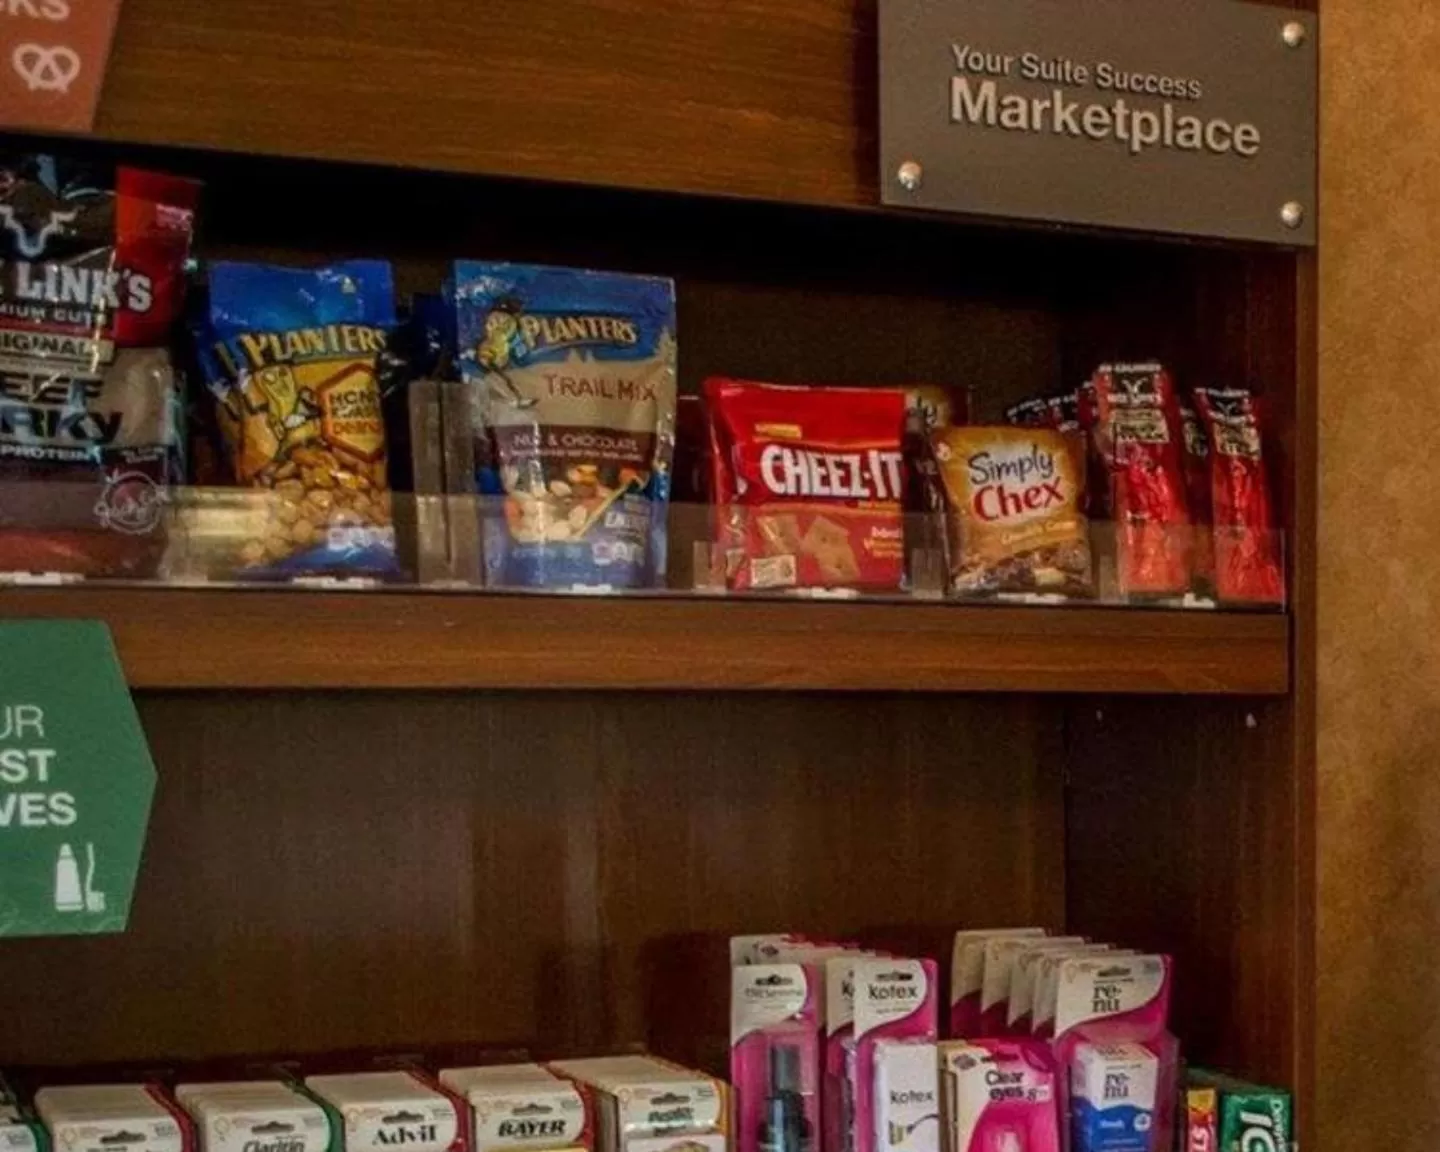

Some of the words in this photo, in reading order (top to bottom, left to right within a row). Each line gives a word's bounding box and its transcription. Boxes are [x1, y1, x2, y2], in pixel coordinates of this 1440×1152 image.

[951, 44, 1013, 76] Your
[1022, 53, 1088, 87] Suite
[1096, 64, 1202, 100] Success
[950, 76, 1262, 156] Marketplace
[17, 262, 152, 312] LINK'S
[241, 324, 388, 367] PLANTERS
[520, 314, 637, 347] PLANTERS
[544, 374, 612, 399] TRAIL
[617, 378, 658, 401] MIX
[760, 445, 902, 498] CHEEZ-IT
[968, 444, 1054, 485] Simply
[974, 476, 1064, 522] Chex
[985, 1069, 1025, 1086] Clear
[373, 1123, 437, 1146] Advil
[498, 1119, 567, 1138] BAYER
